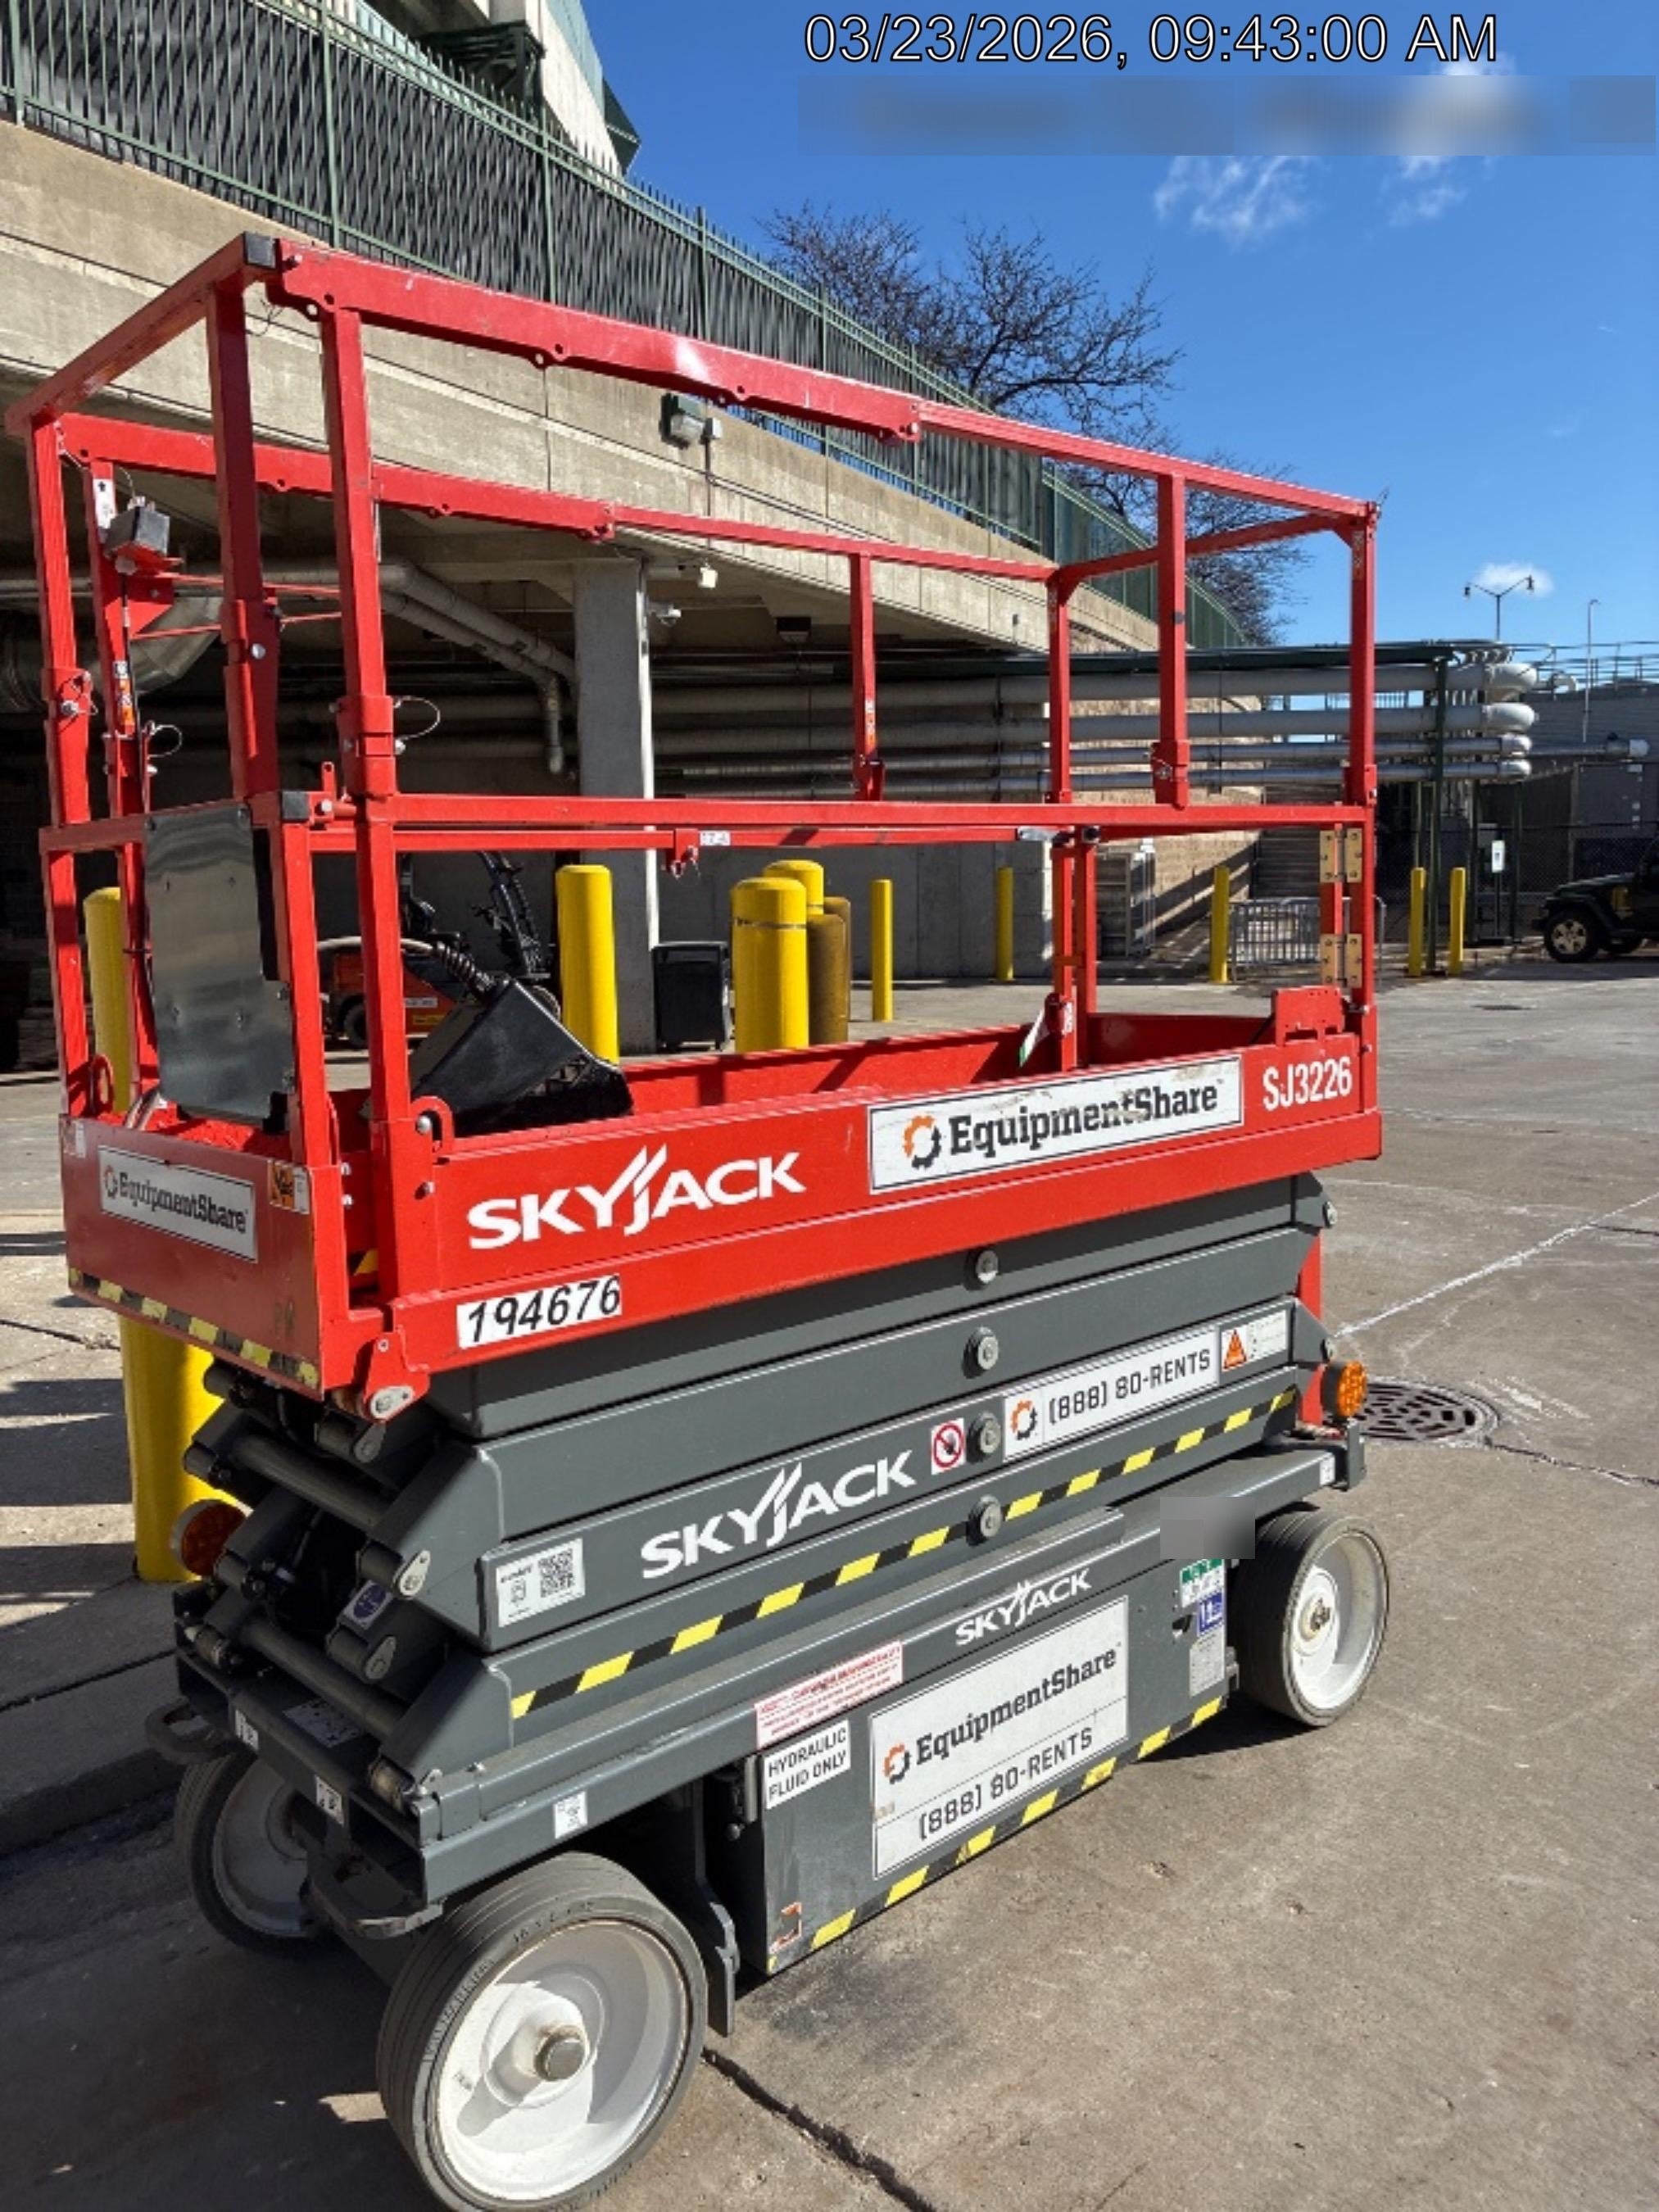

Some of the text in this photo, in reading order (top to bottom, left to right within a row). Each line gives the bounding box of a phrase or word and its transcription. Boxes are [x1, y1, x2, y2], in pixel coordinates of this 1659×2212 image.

[950, 1082, 1218, 1158] EquipmentShare
[1262, 1057, 1352, 1112] SJ3226
[120, 1172, 247, 1234] EquipmentShare
[466, 1144, 806, 1250] SKYJACK
[467, 1275, 621, 1344] 194676
[1049, 1349, 1212, 1425] (888) 80-RENTS
[641, 1450, 917, 1579] SKYJACK
[955, 1567, 1092, 1647] SKYJACK
[916, 1648, 1117, 1766] EquipmentShare
[768, 1727, 846, 1778] HYDRAULIC
[768, 1750, 846, 1801] FLUID ONLY
[918, 1727, 1094, 1839] (888) 80-RENTS
